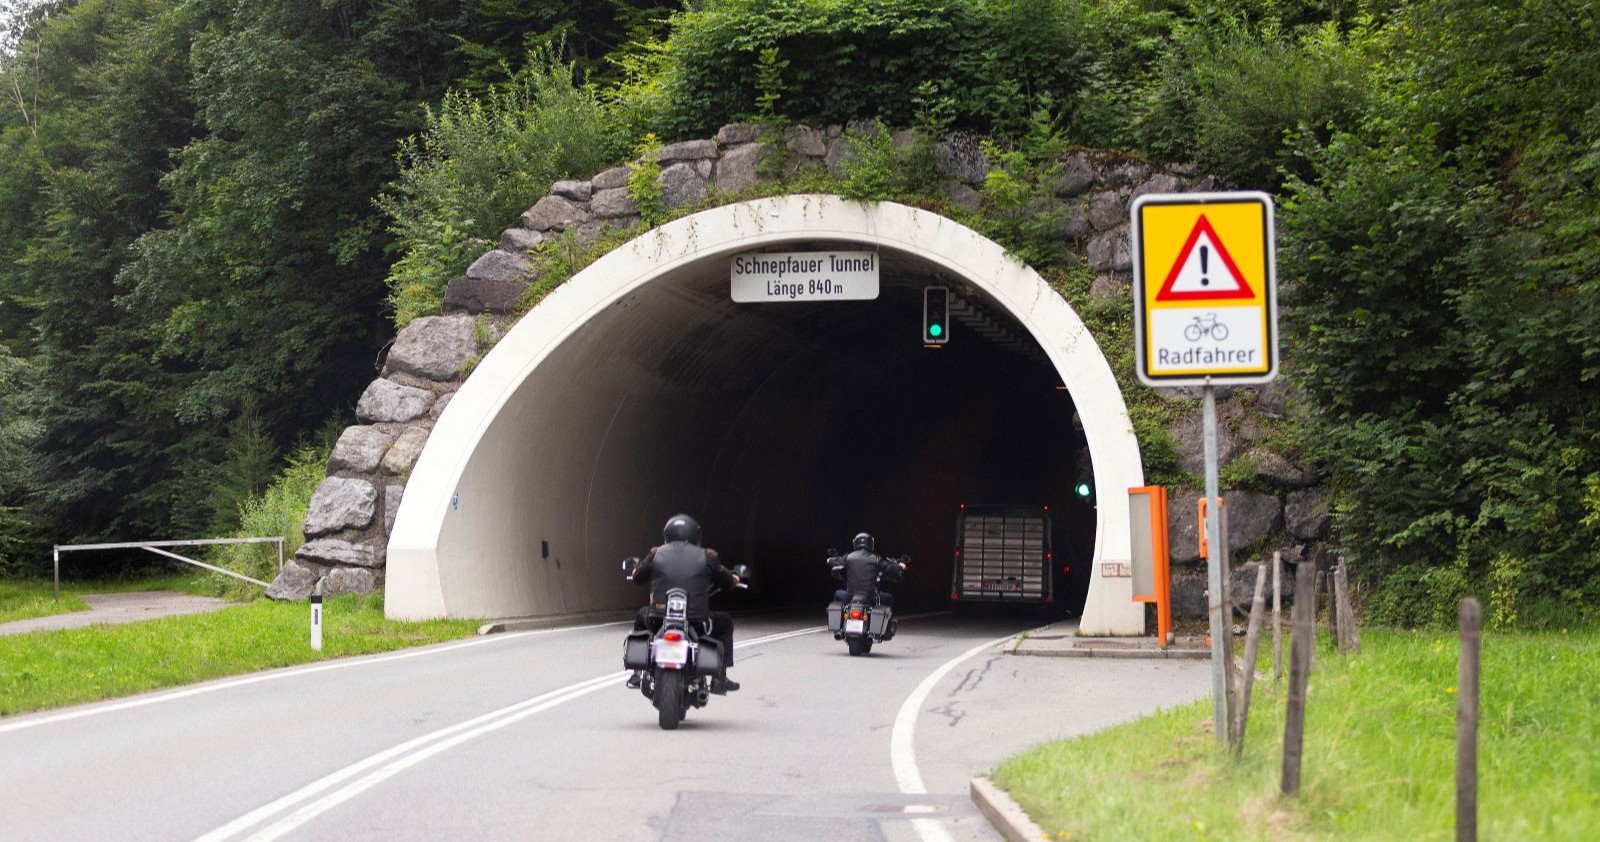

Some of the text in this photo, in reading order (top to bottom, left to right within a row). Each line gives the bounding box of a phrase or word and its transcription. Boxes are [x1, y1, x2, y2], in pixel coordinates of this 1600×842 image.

[735, 254, 874, 278] Schnepfauer Tunnel
[767, 279, 843, 299] Länge 840 m
[1159, 347, 1255, 365] Radfahrer
